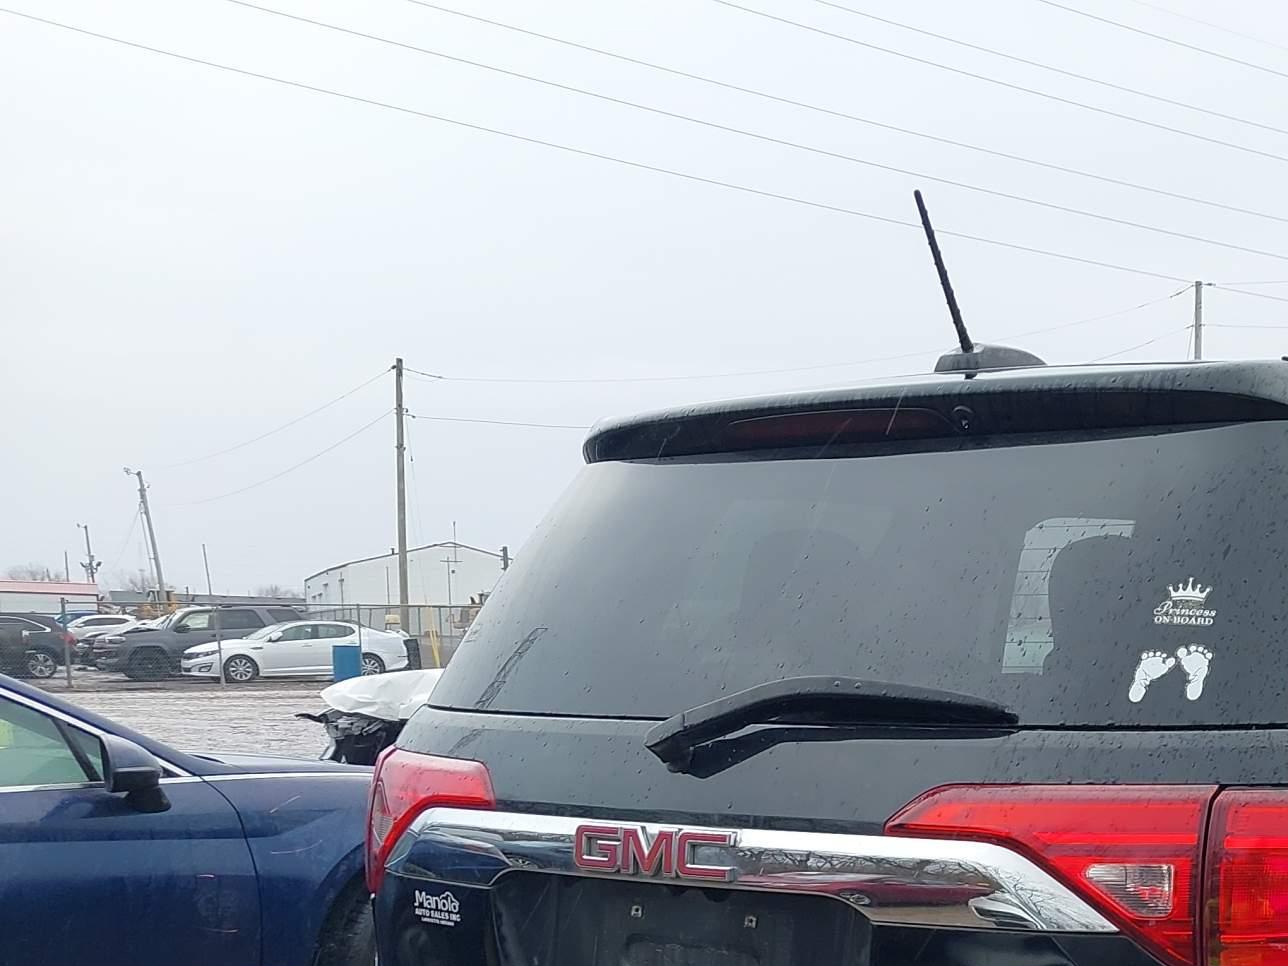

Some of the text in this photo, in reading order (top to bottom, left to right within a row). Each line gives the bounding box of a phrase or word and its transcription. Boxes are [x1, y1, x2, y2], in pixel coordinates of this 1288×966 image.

[1153, 600, 1217, 617] Princess
[1173, 616, 1214, 626] BOARD
[575, 824, 738, 882] GMC
[414, 889, 460, 913] Manolo
[430, 910, 449, 920] SALES
